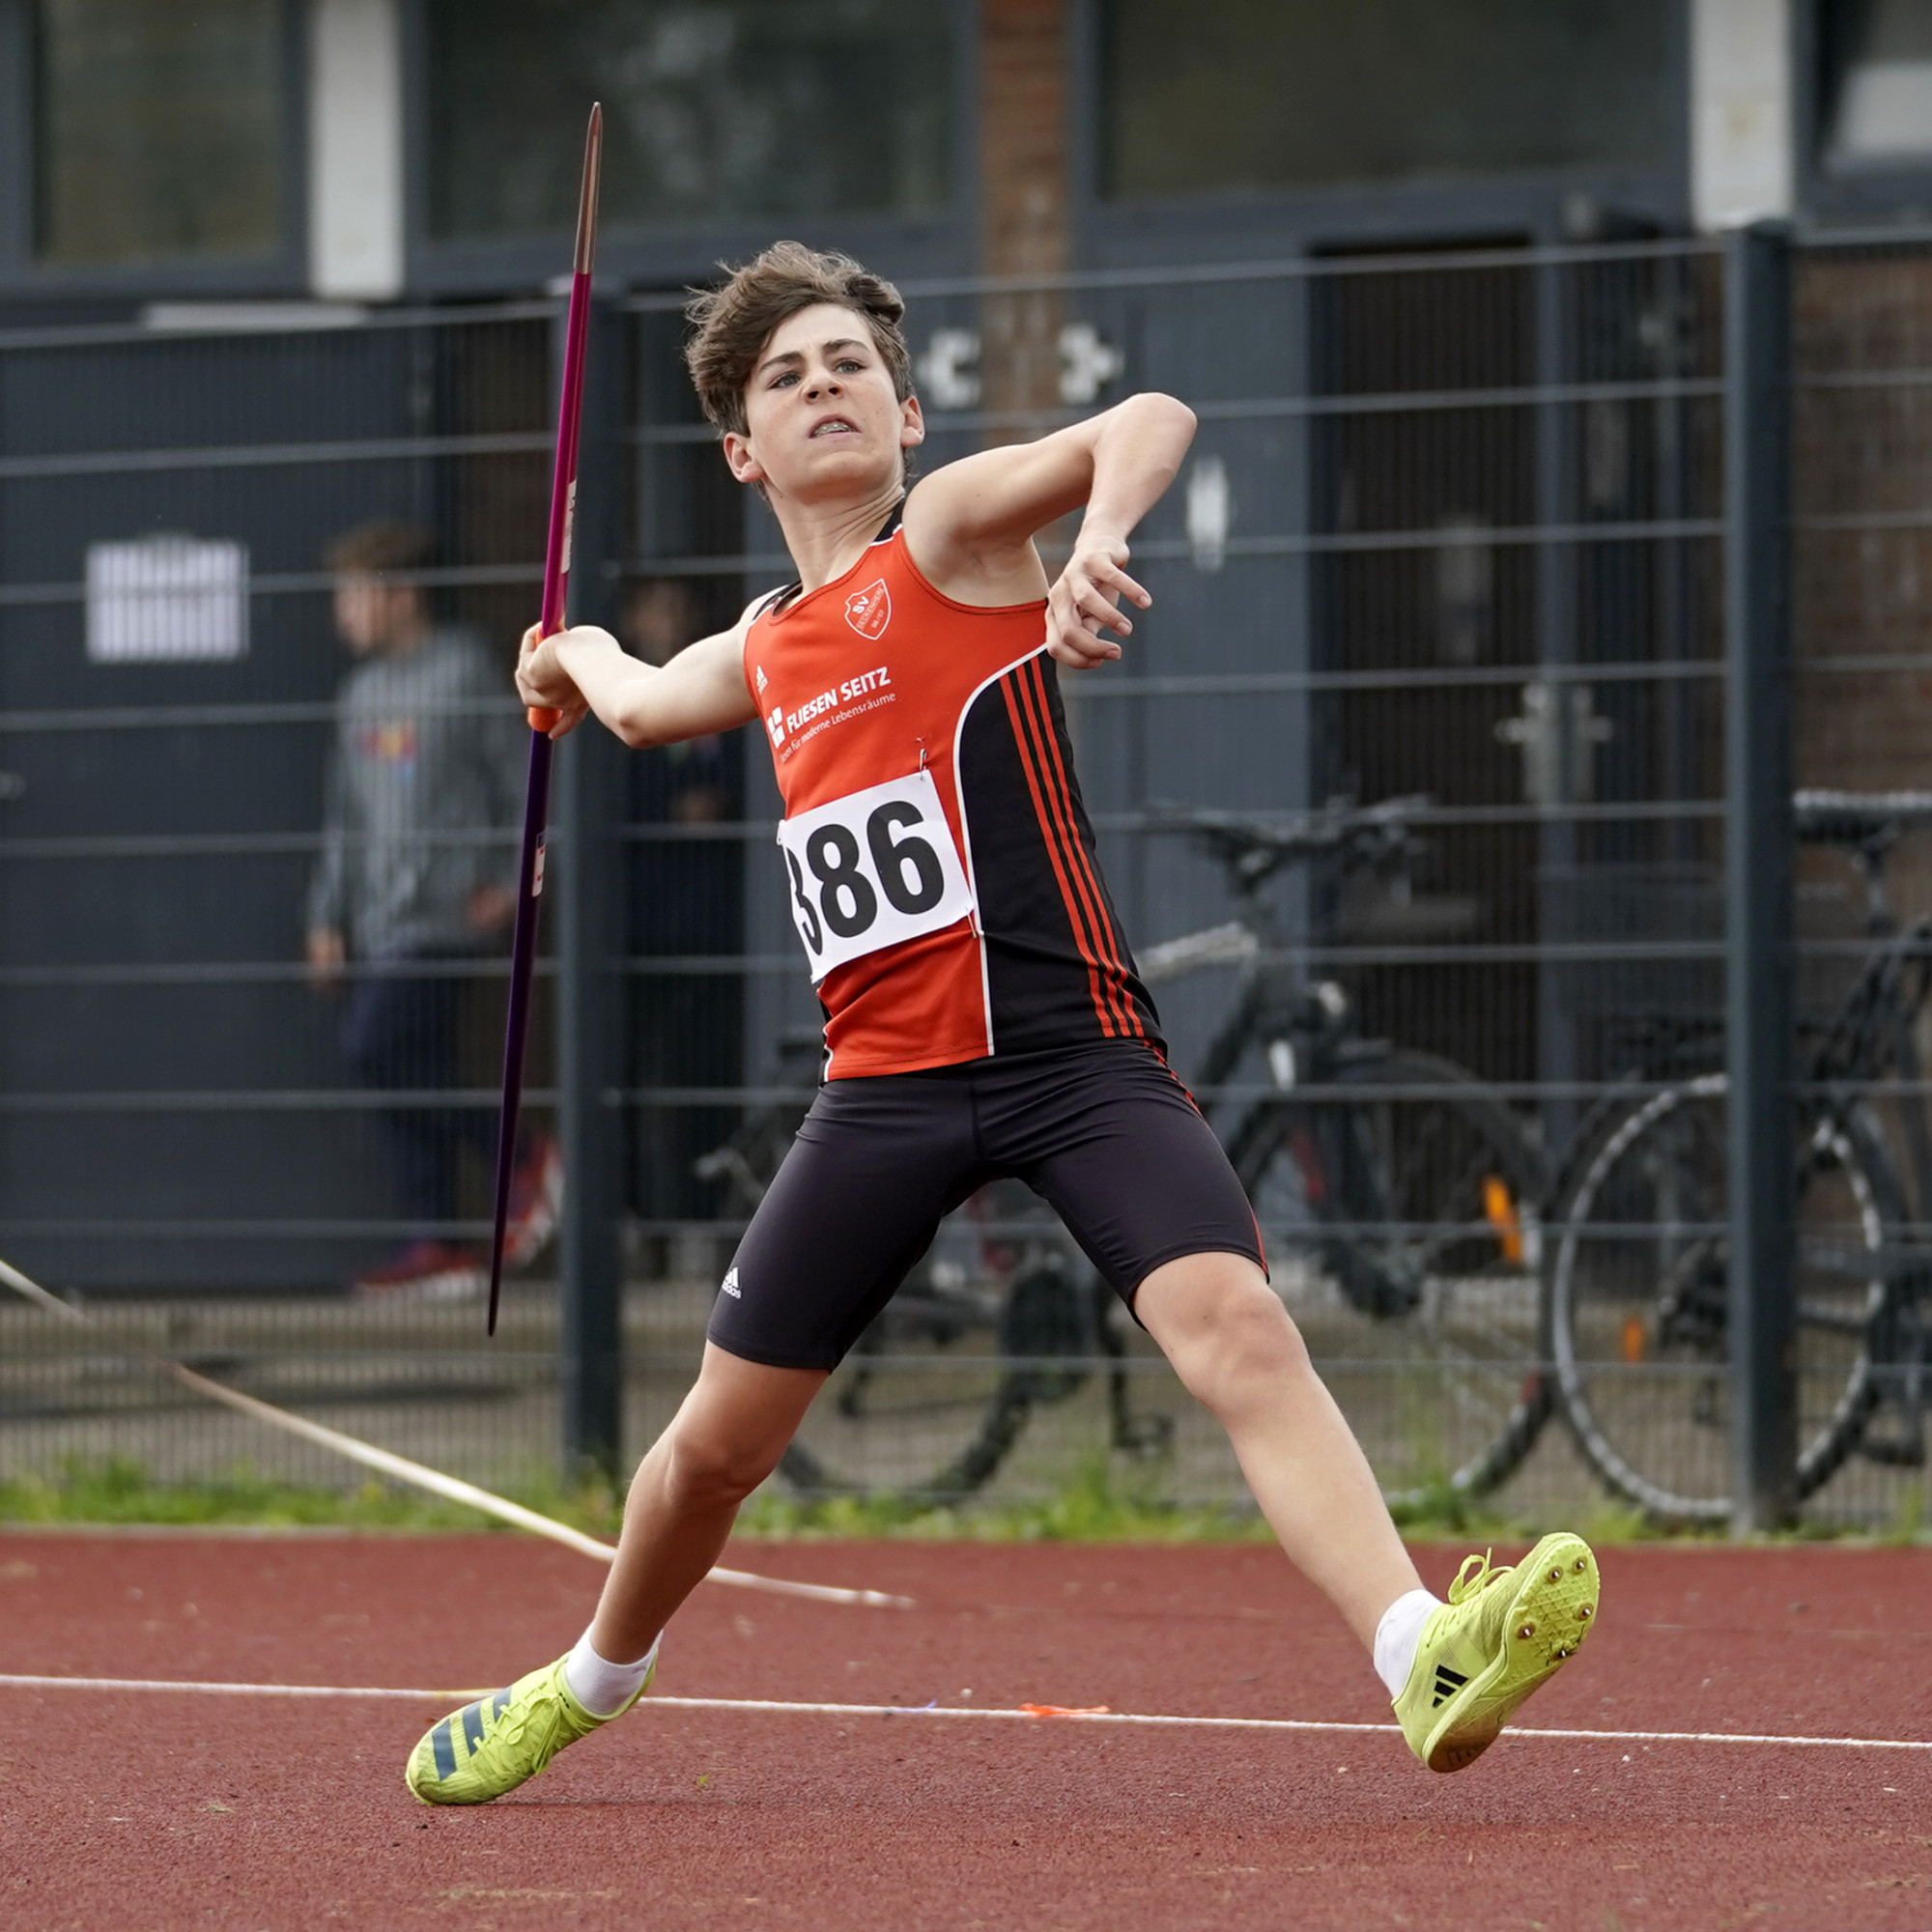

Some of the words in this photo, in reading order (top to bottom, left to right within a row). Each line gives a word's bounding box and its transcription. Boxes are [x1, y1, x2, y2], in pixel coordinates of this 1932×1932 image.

[852, 595, 869, 614] SV
[785, 688, 838, 734] FLIESEN
[839, 667, 892, 701] SEITZ
[831, 693, 896, 724] Lebensräume
